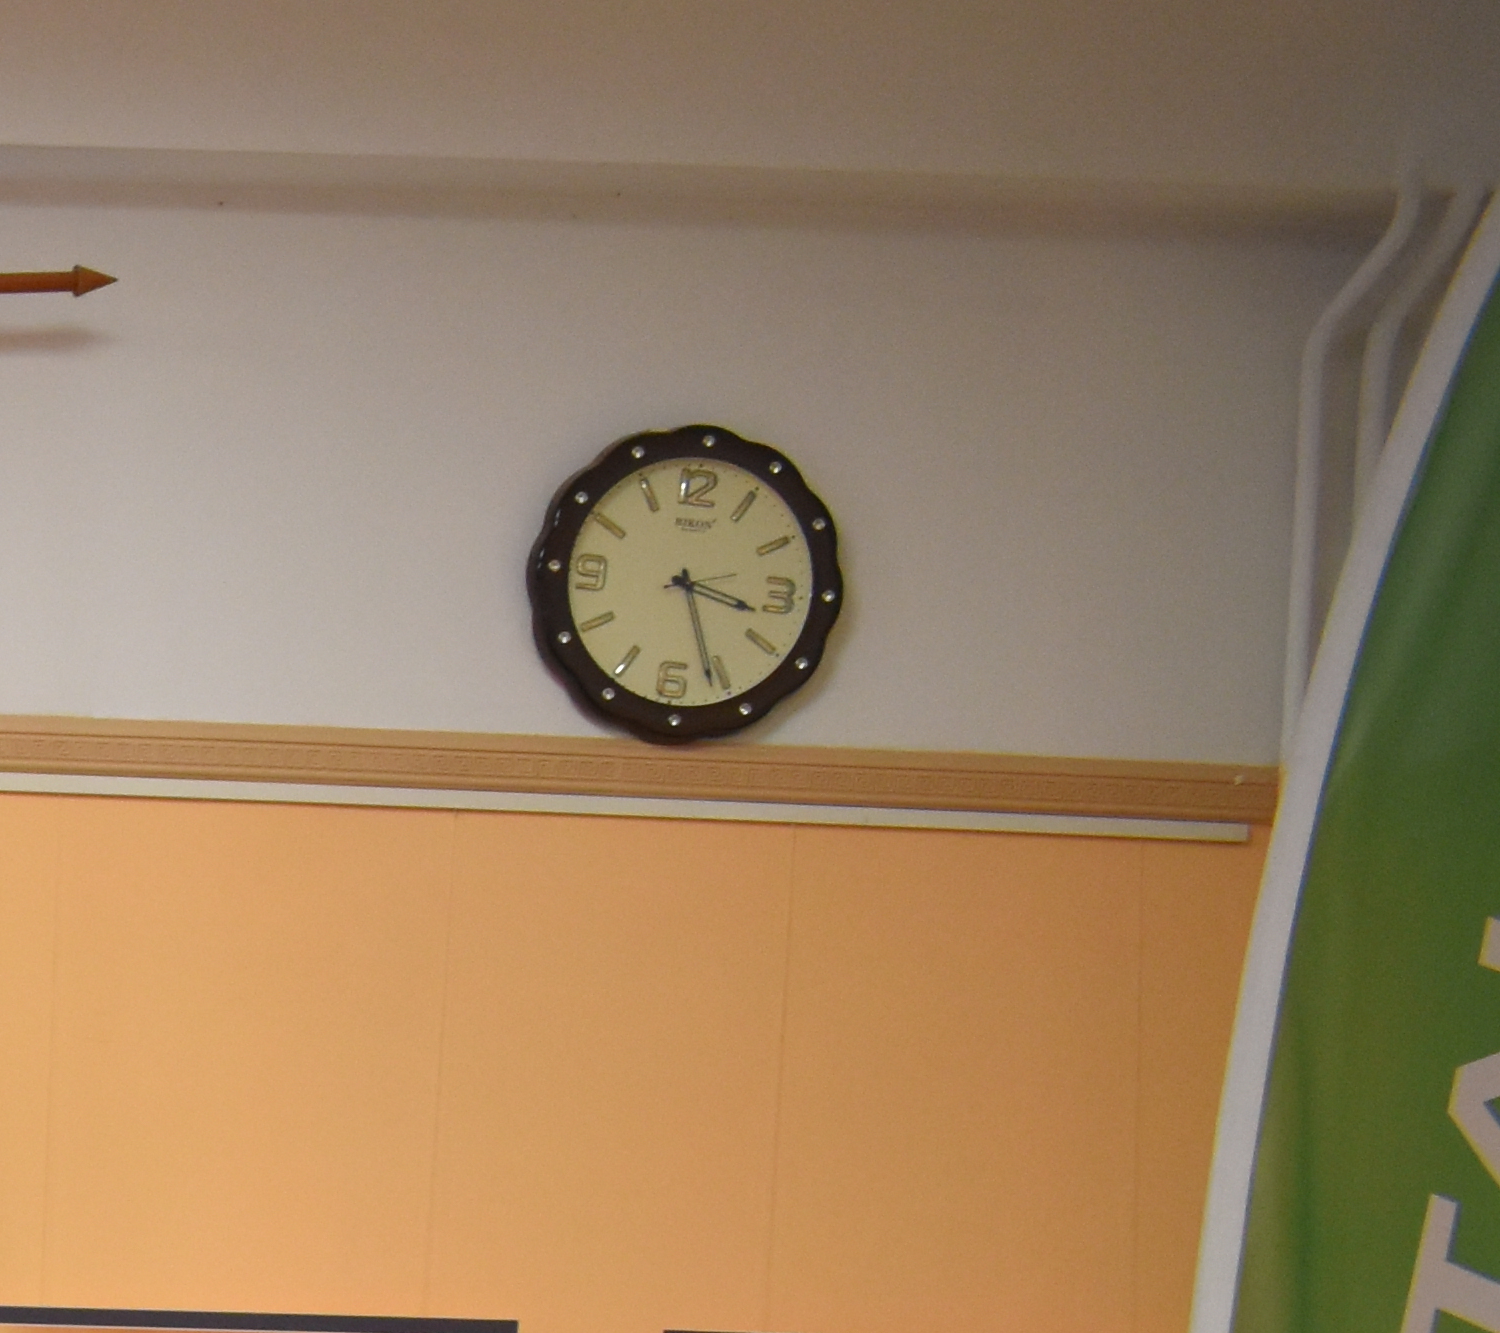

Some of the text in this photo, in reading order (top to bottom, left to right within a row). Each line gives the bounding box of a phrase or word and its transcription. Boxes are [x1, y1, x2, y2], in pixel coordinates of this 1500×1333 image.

[575, 554, 607, 591] 9
[762, 577, 796, 614] 3
[656, 661, 689, 698] 6
